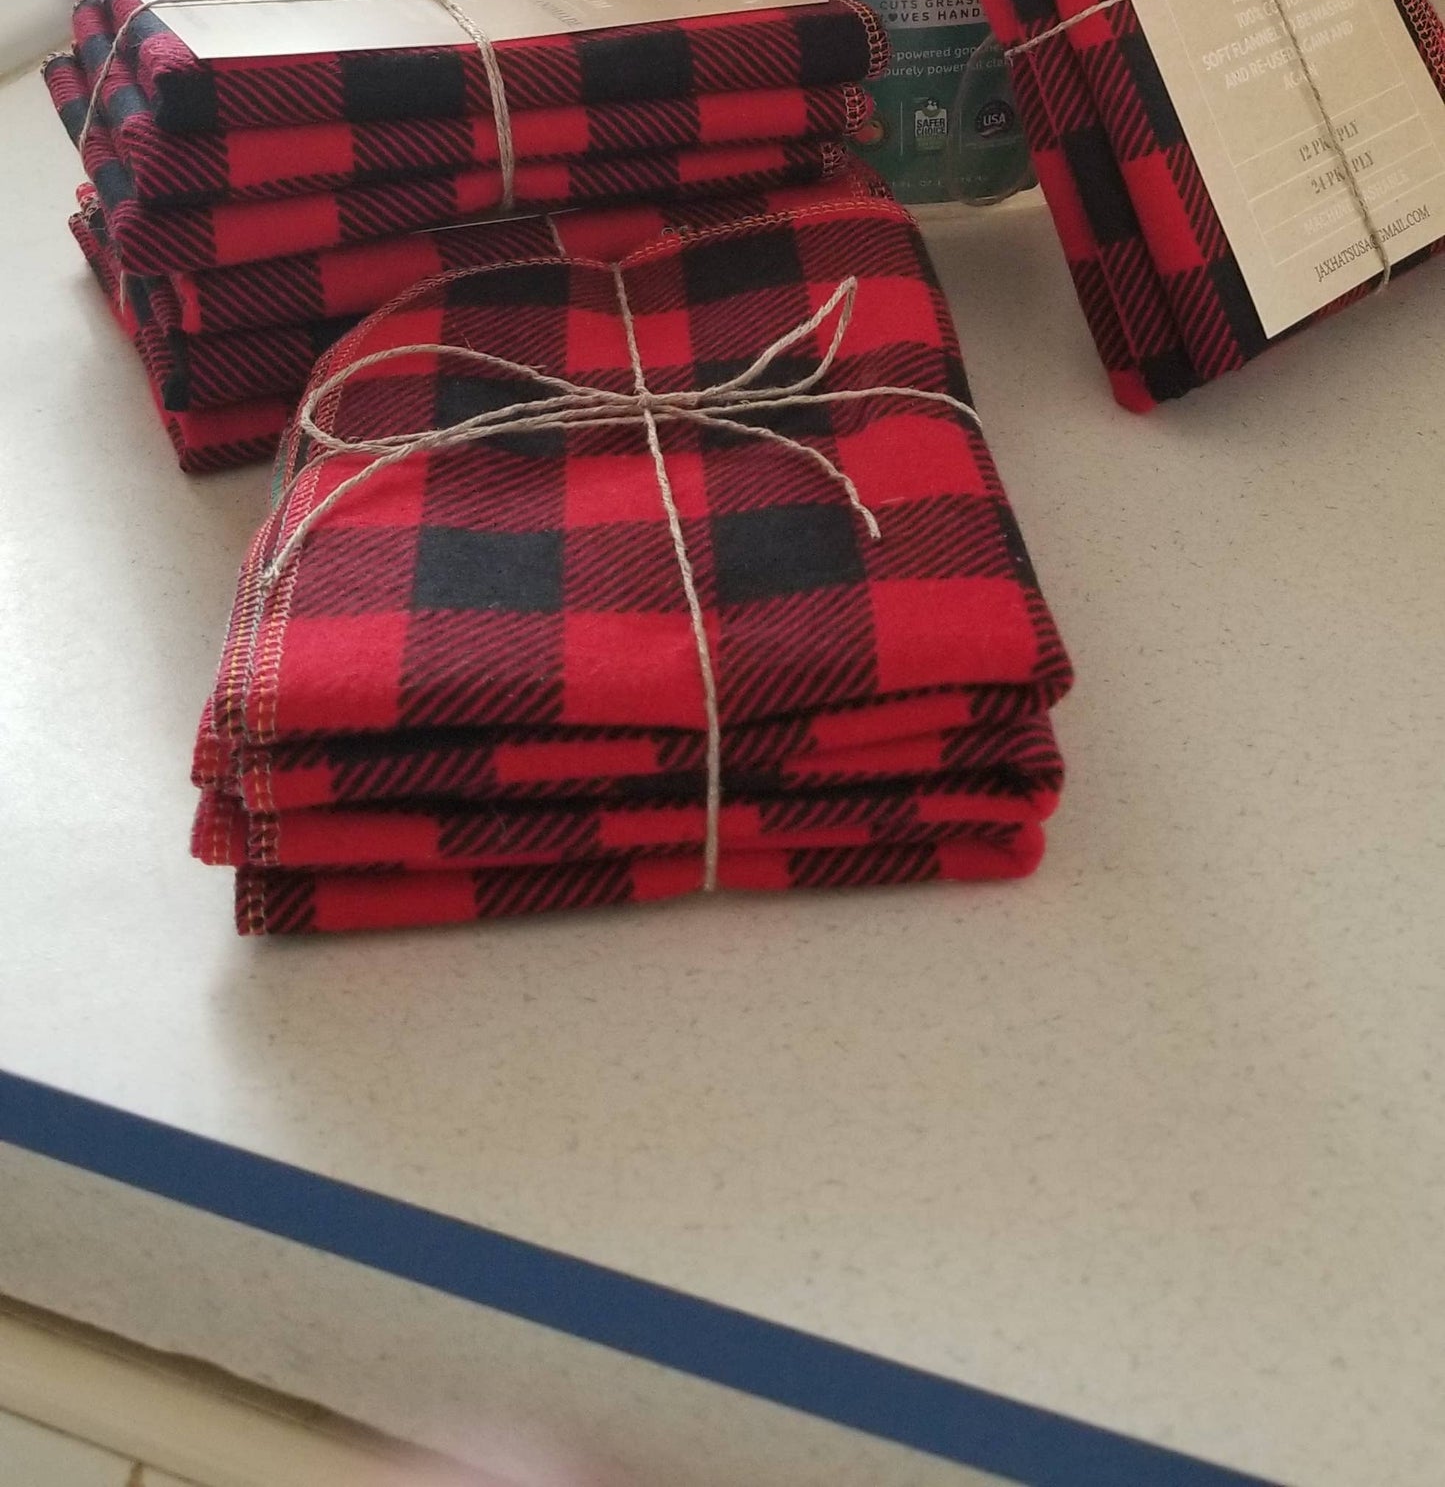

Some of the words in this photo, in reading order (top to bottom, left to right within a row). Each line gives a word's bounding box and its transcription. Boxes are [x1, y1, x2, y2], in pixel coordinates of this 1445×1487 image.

[880, 0, 918, 11] CUTS
[937, 8, 982, 21] HAND
[890, 46, 951, 62] -powered
[1202, 44, 1232, 71] SOFT
[1230, 25, 1283, 56] FLANNEL
[1225, 66, 1249, 90] AND
[1249, 47, 1296, 75] RE-USED
[916, 117, 946, 128] SAFER
[983, 114, 1006, 127] USA
[916, 125, 946, 136] CHOICE
[1299, 144, 1313, 162] 12
[1311, 135, 1332, 156] PK
[1324, 165, 1346, 187] PK
